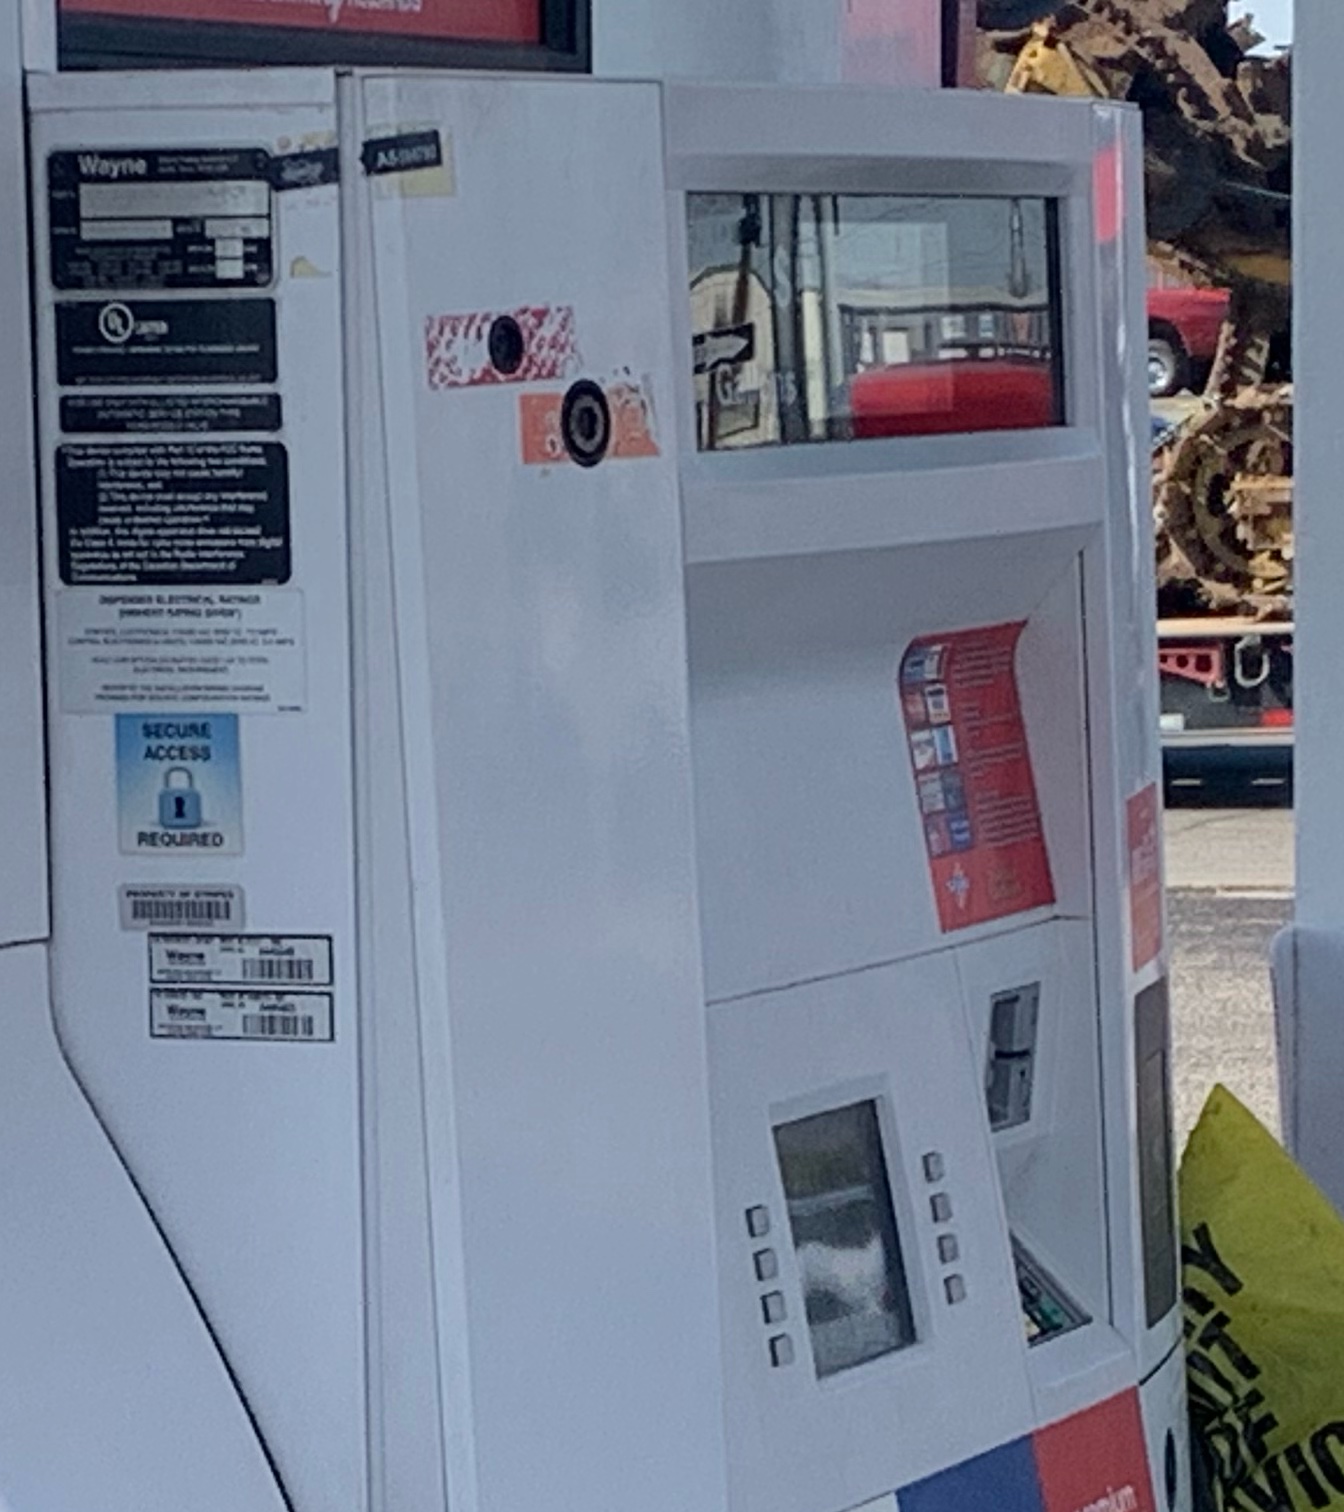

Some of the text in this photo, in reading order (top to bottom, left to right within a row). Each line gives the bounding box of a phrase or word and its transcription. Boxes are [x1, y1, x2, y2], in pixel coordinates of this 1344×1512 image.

[77, 154, 148, 178] Wayne
[141, 722, 212, 740] SECURE
[142, 745, 212, 763] ACCESS
[136, 831, 224, 848] REQUIRED
